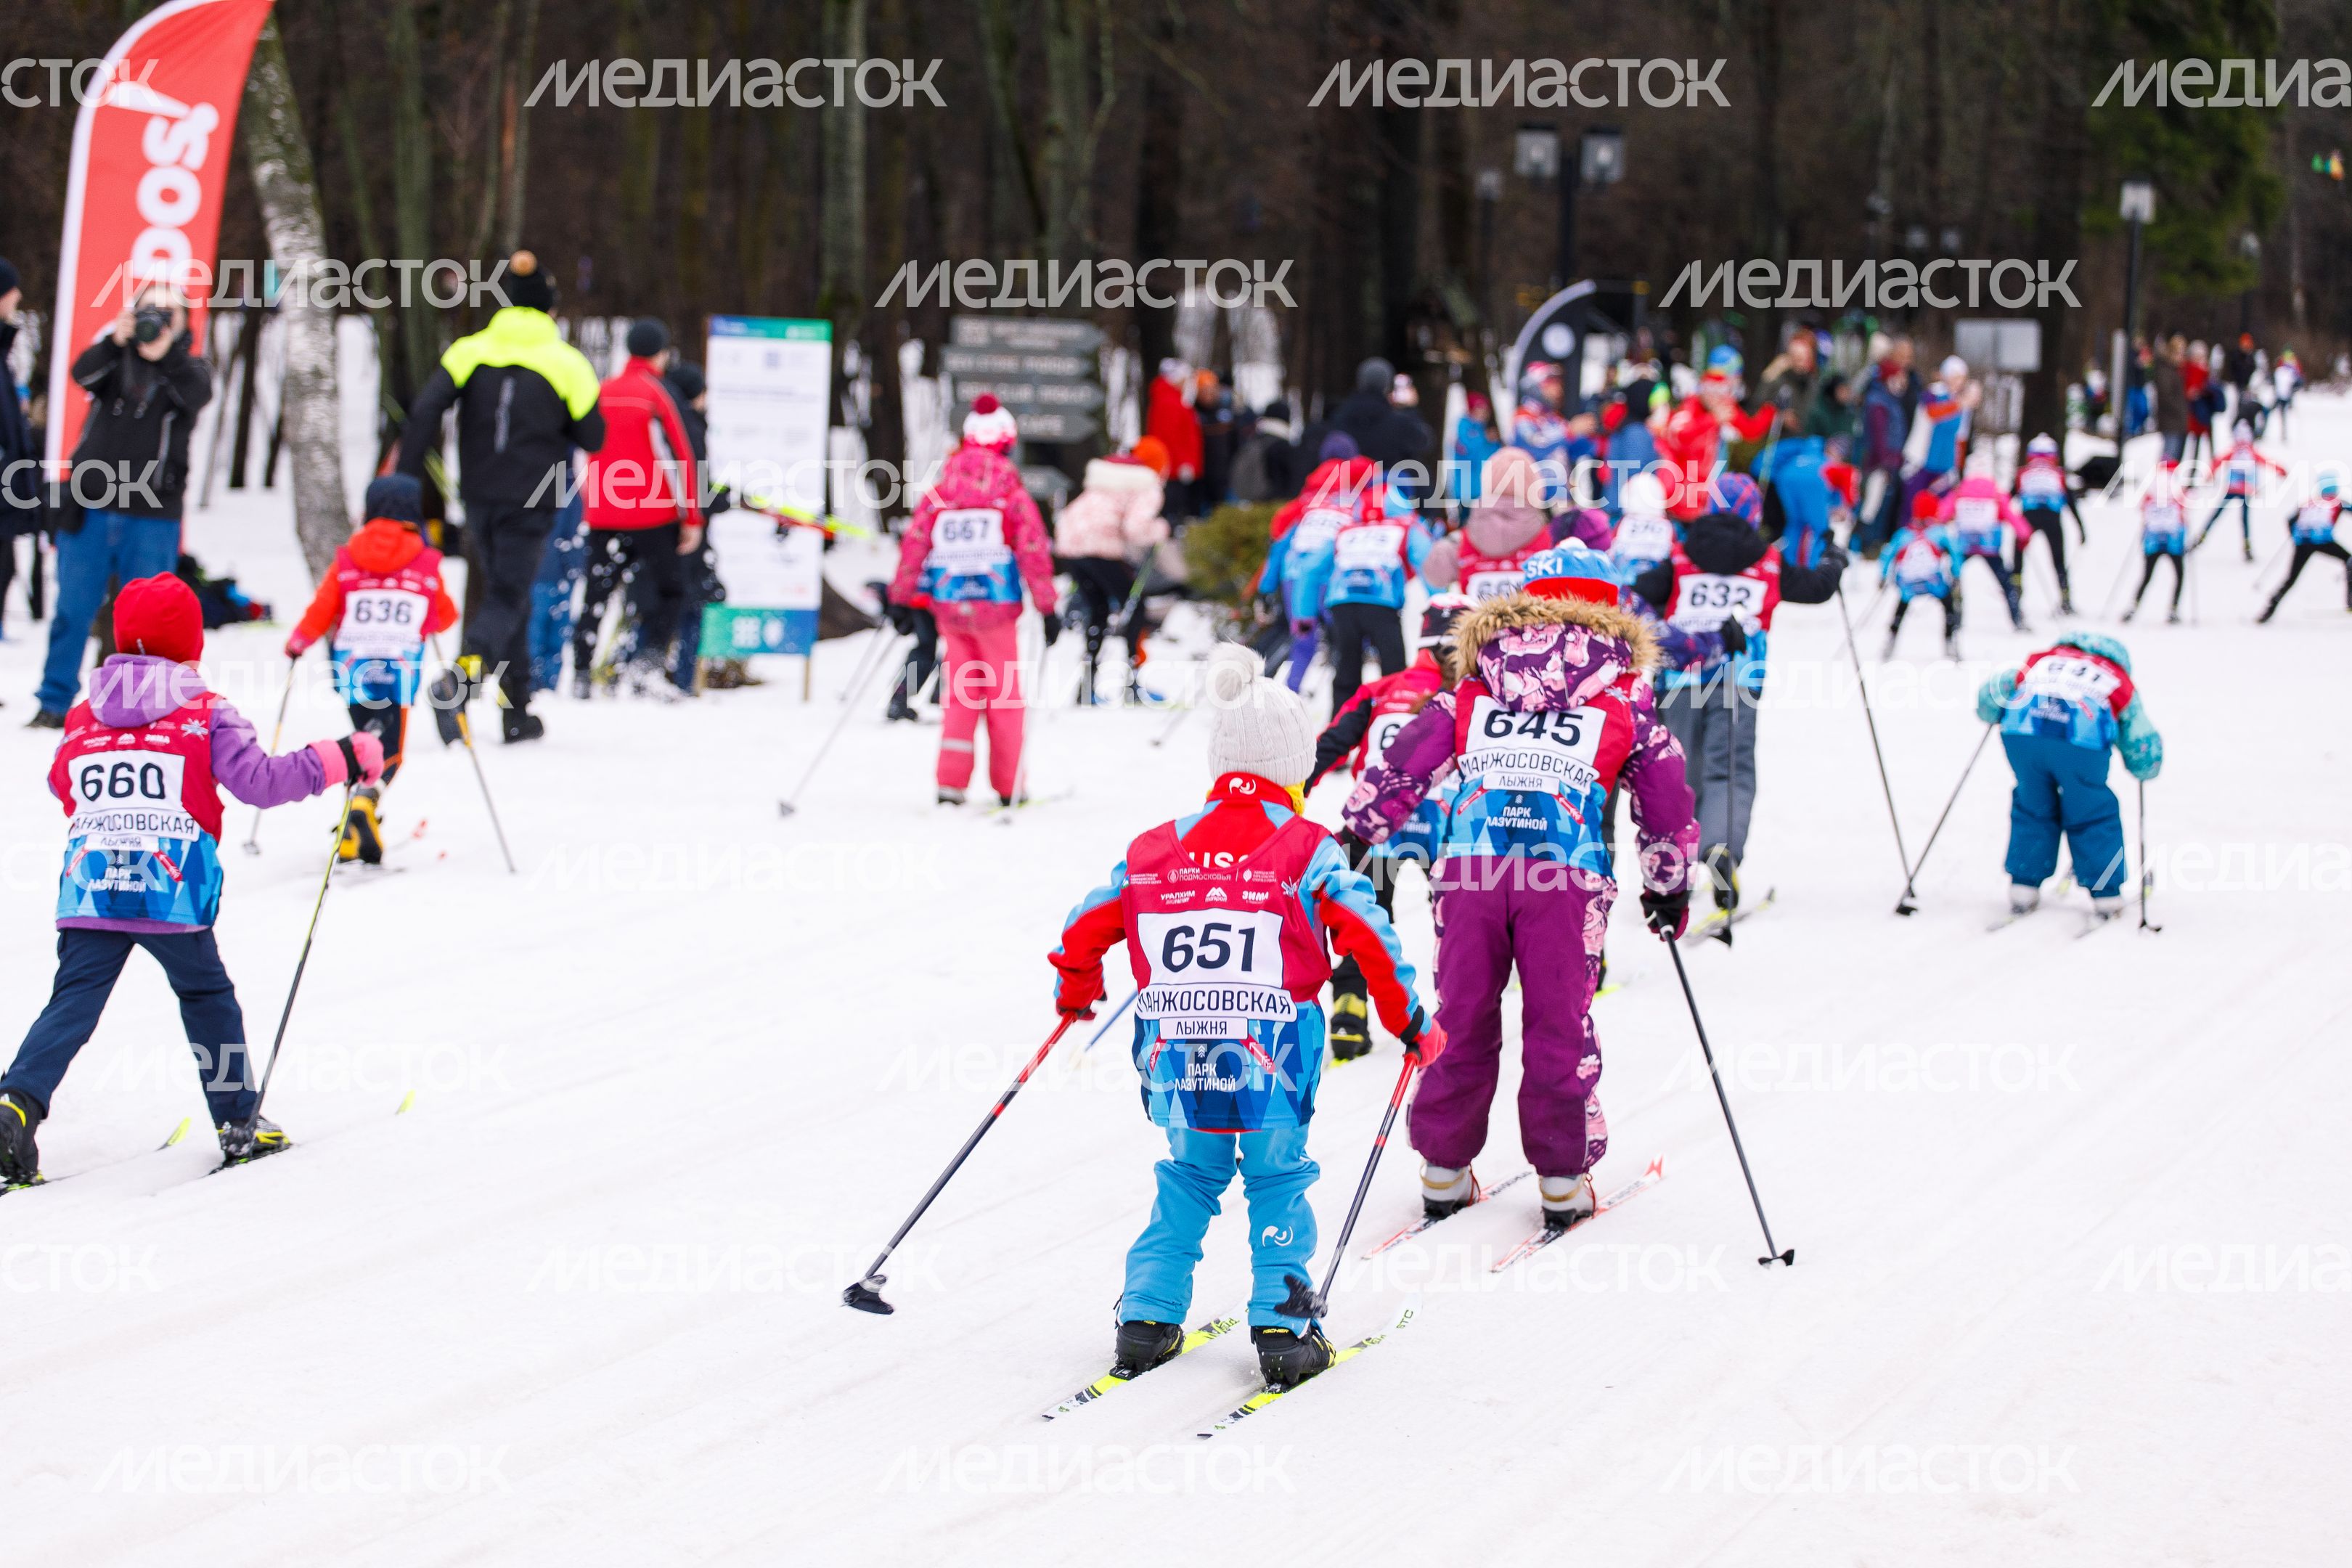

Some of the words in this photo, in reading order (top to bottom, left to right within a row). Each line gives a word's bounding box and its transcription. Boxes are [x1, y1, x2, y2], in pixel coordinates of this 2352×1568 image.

[944, 518, 989, 542] 667
[1527, 558, 1563, 579] SKI
[1691, 583, 1751, 608] 632
[355, 599, 412, 624] 636
[1484, 709, 1584, 746] 645
[81, 762, 166, 802] 660
[1499, 775, 1543, 788] ЛЫЖНЯ
[1503, 806, 1532, 818] ПАРК
[1487, 816, 1548, 831] ЛАЗУТИНОЙ
[105, 867, 132, 879] ПАРК
[1179, 867, 1201, 875] ПАРКИ
[1179, 872, 1232, 881] ПОДМОСКОВЬЯ
[1160, 890, 1196, 901] УРАЛХИМ
[1162, 923, 1256, 973] 651
[1137, 989, 1291, 1016] МАНЖОСОВСКАЯ
[1176, 1020, 1228, 1036] ЛЫЖНЯ
[1188, 1063, 1217, 1077] ПАРК
[1174, 1074, 1236, 1092] ЛАЗУТИНОЙ
